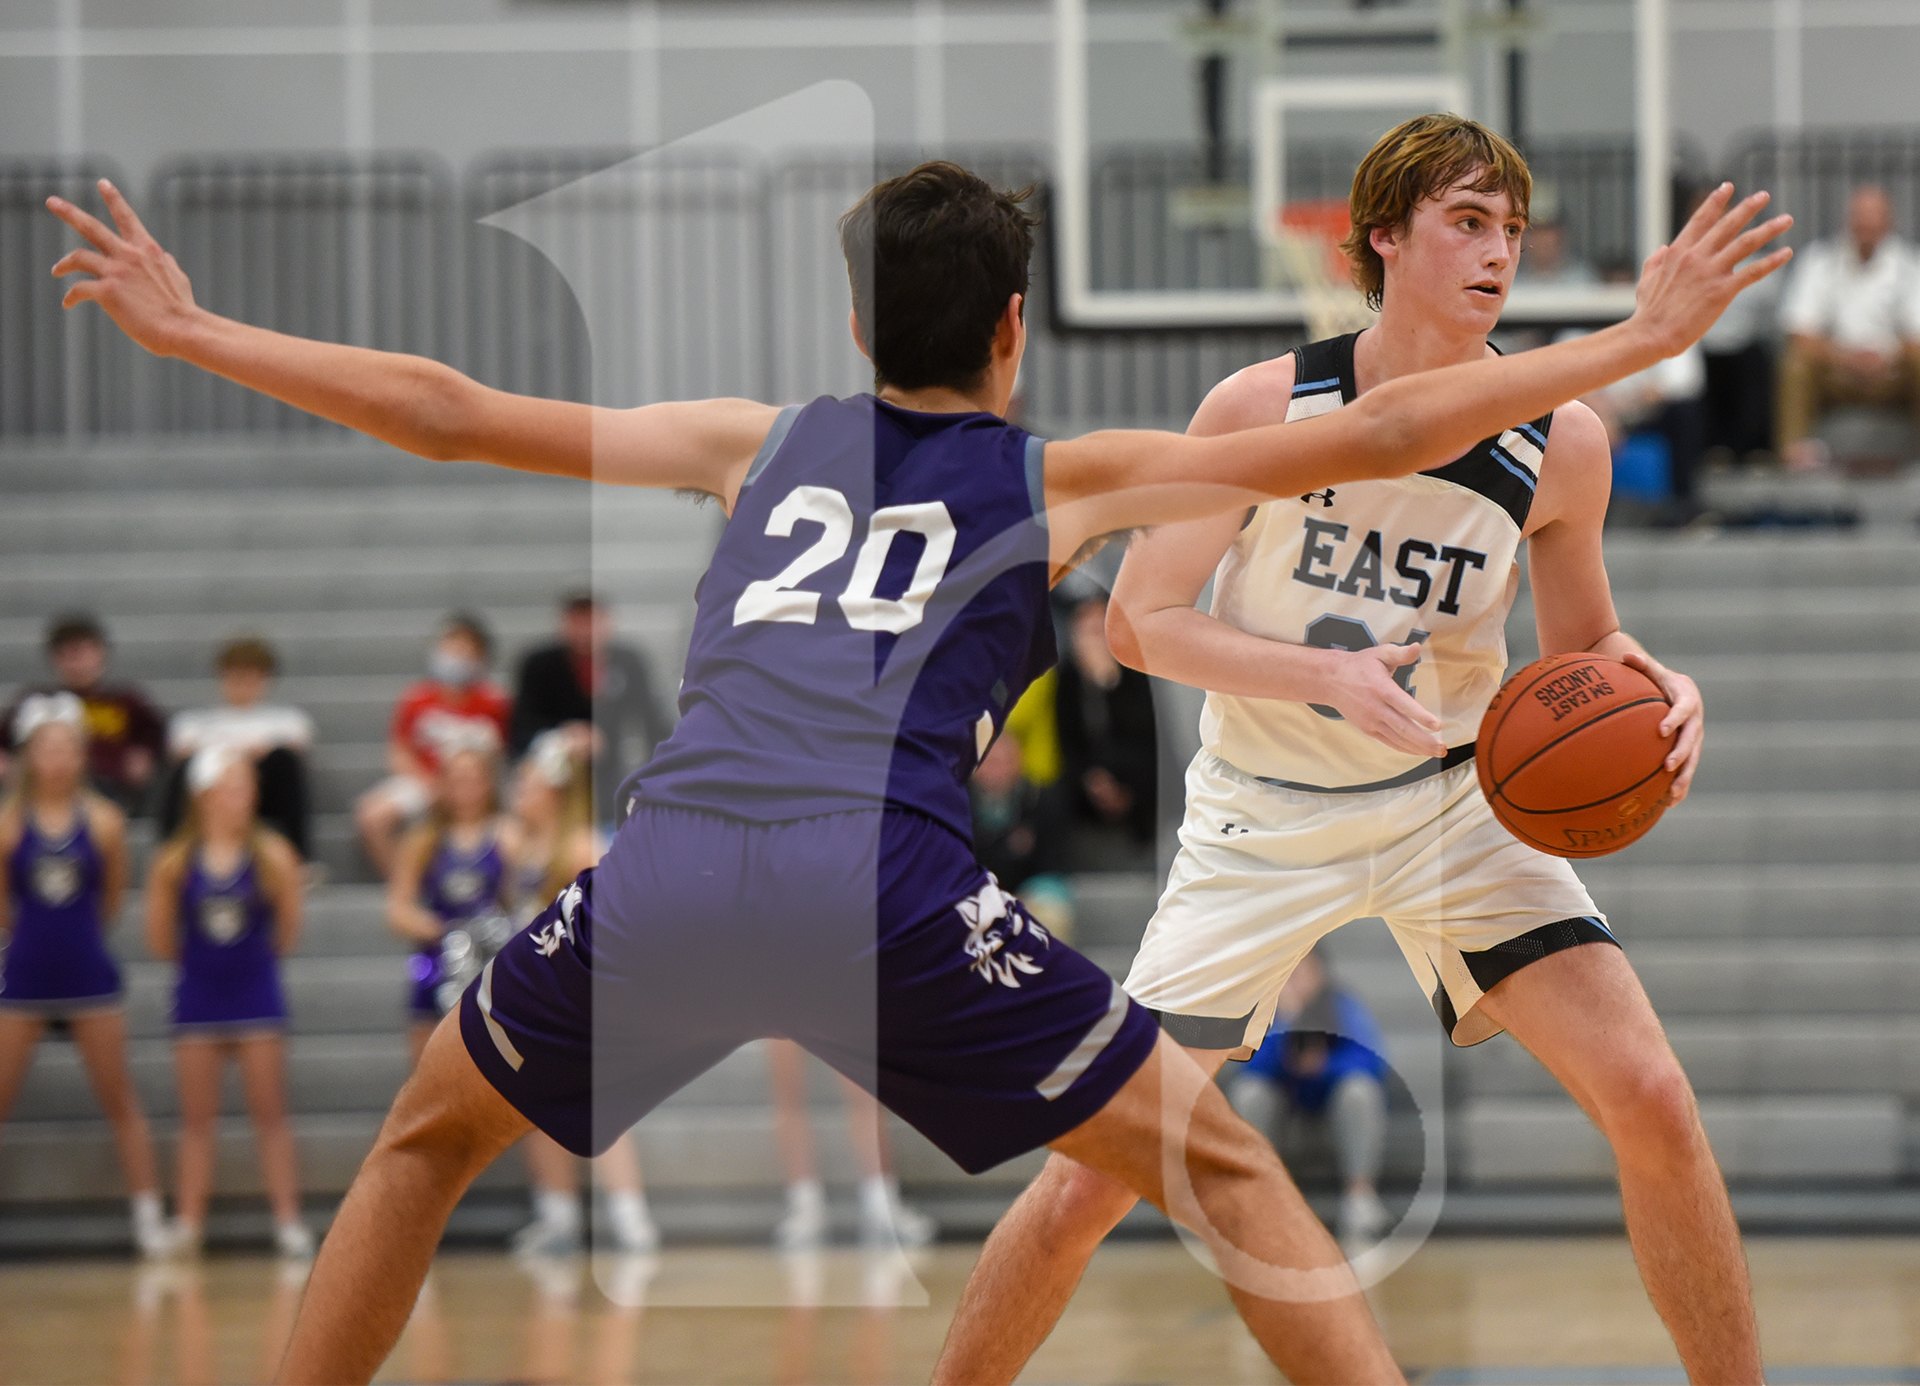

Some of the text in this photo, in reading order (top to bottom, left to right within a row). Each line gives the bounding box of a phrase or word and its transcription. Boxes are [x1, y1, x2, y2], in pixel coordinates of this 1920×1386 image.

[733, 485, 957, 634] 20
[1292, 516, 1487, 616] EAST
[1534, 665, 1605, 706] LANCERS
[1551, 681, 1615, 721] SM EAST
